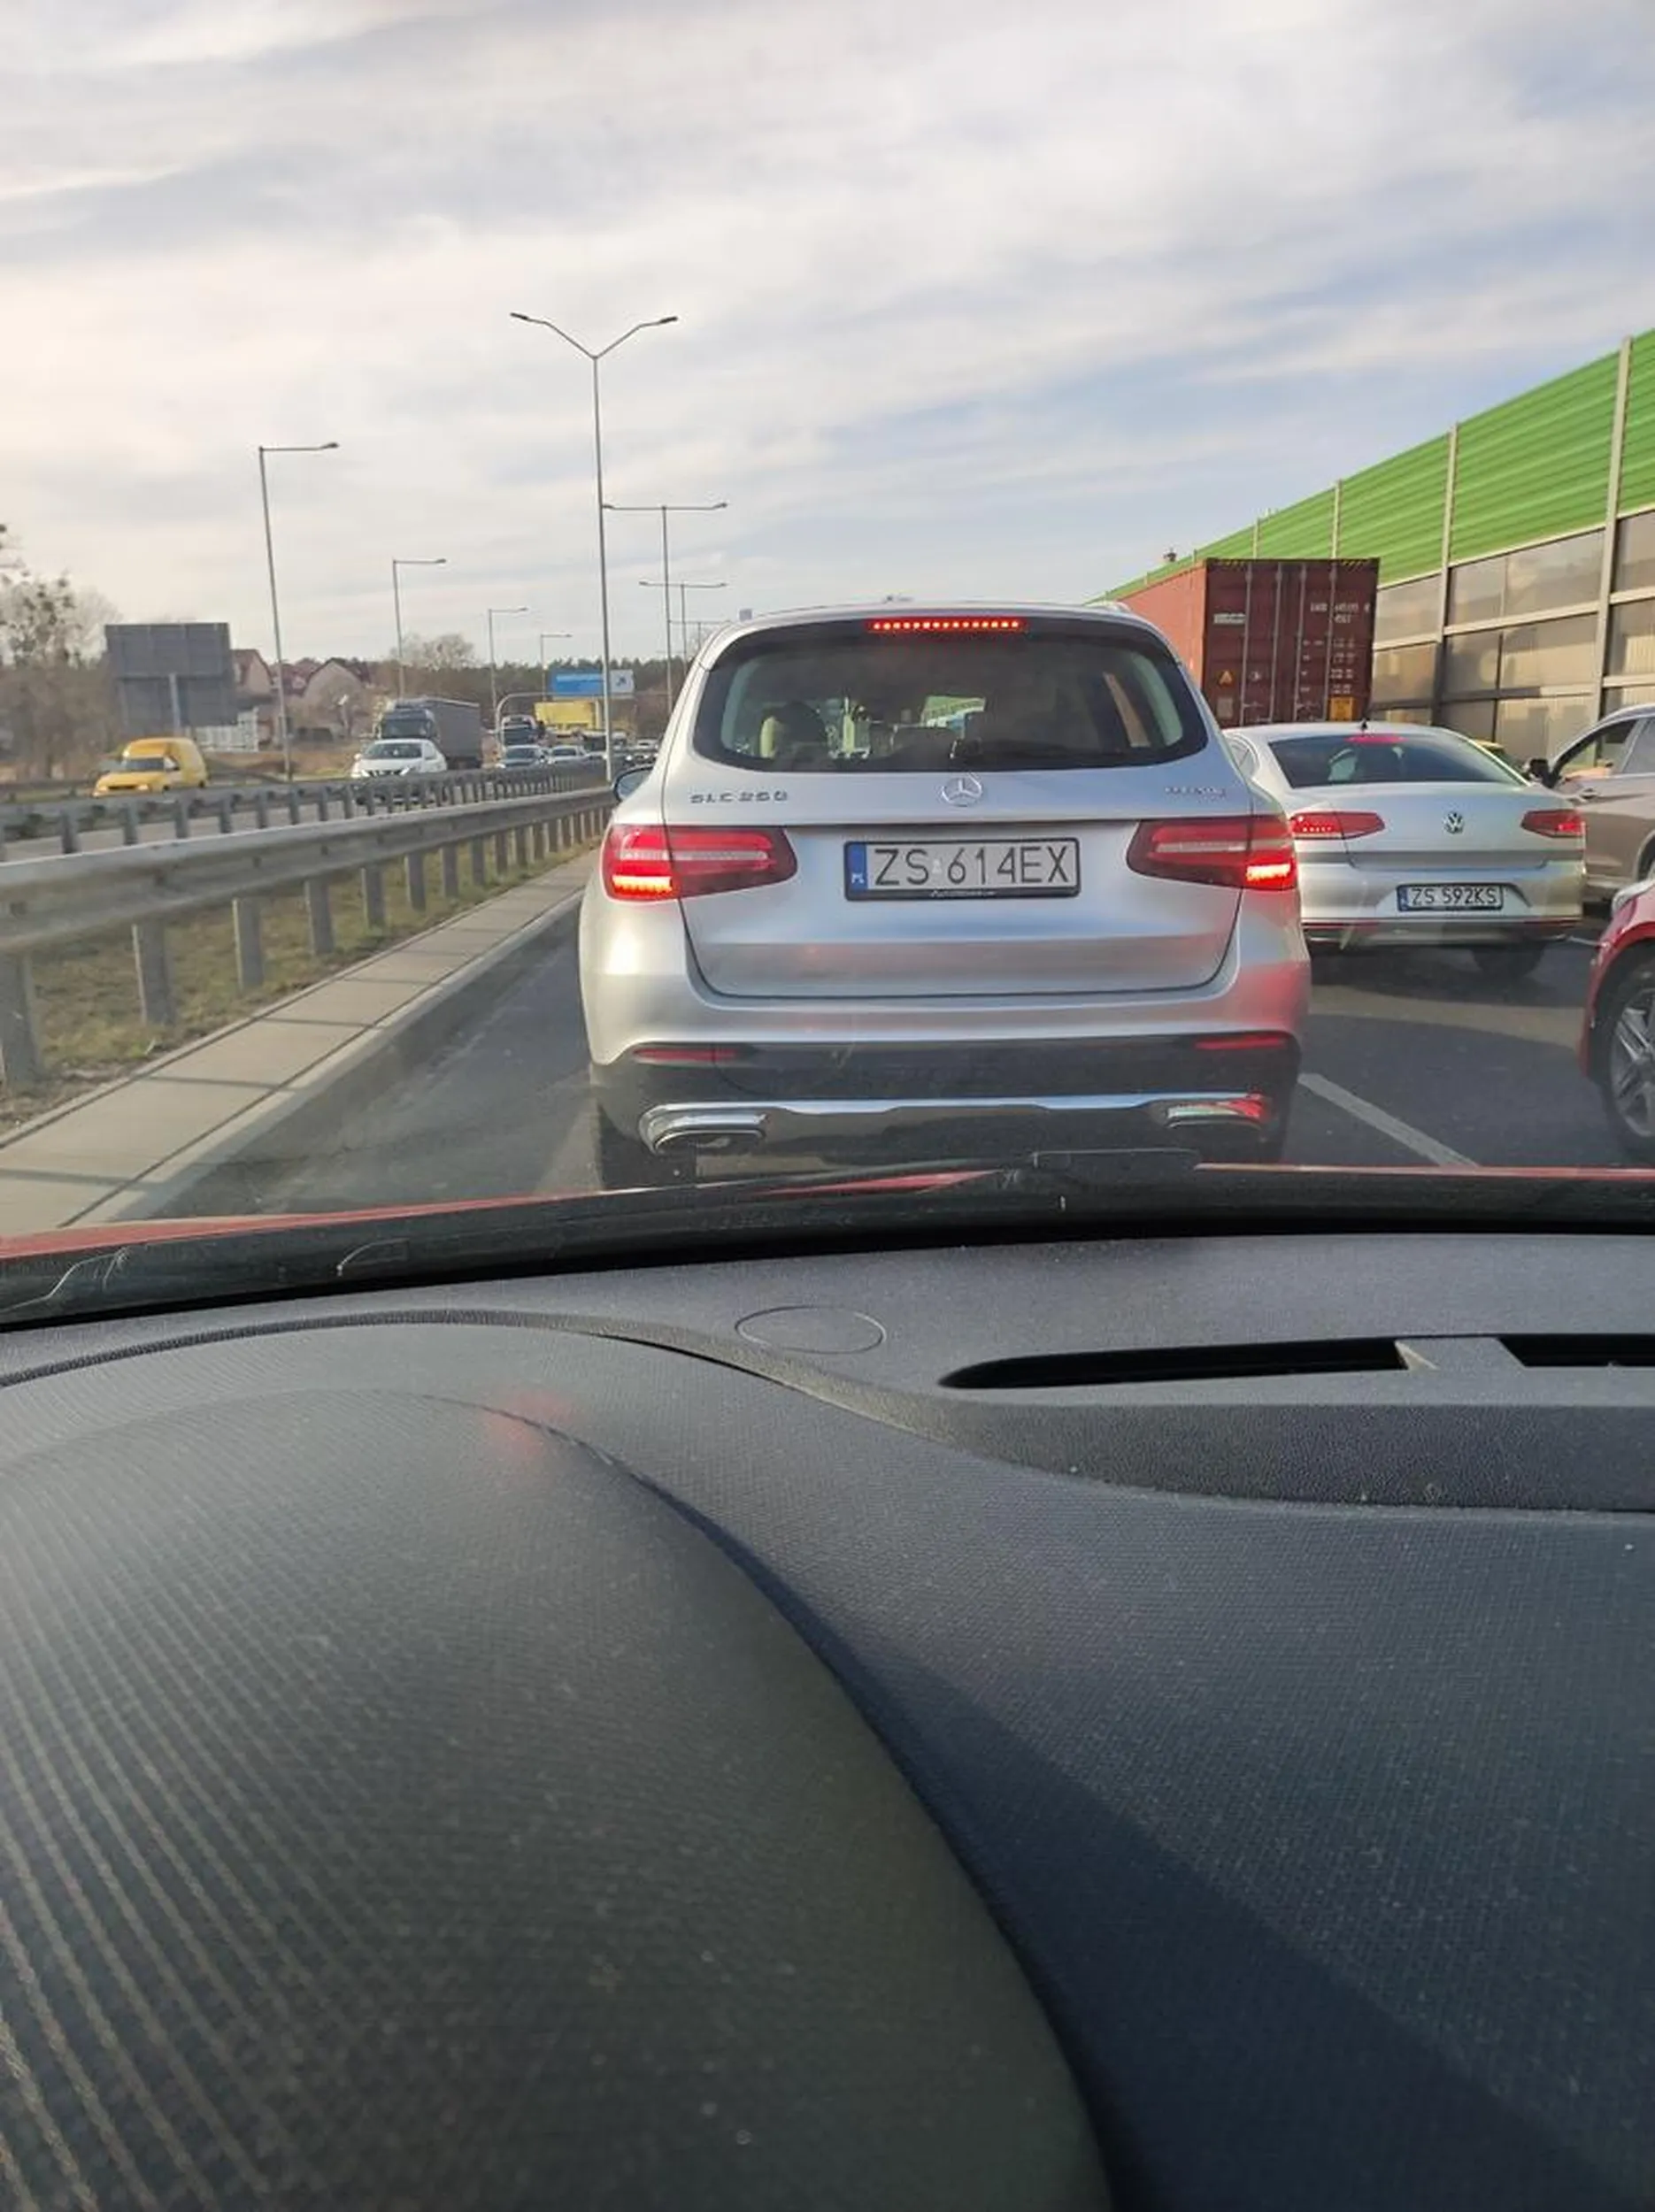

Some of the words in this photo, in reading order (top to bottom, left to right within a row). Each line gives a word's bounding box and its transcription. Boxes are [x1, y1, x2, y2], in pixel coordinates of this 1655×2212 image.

[874, 848, 929, 886] ZS
[947, 846, 1069, 885] 614EX
[1411, 887, 1436, 906] ZS
[1441, 887, 1497, 905] 592KS
